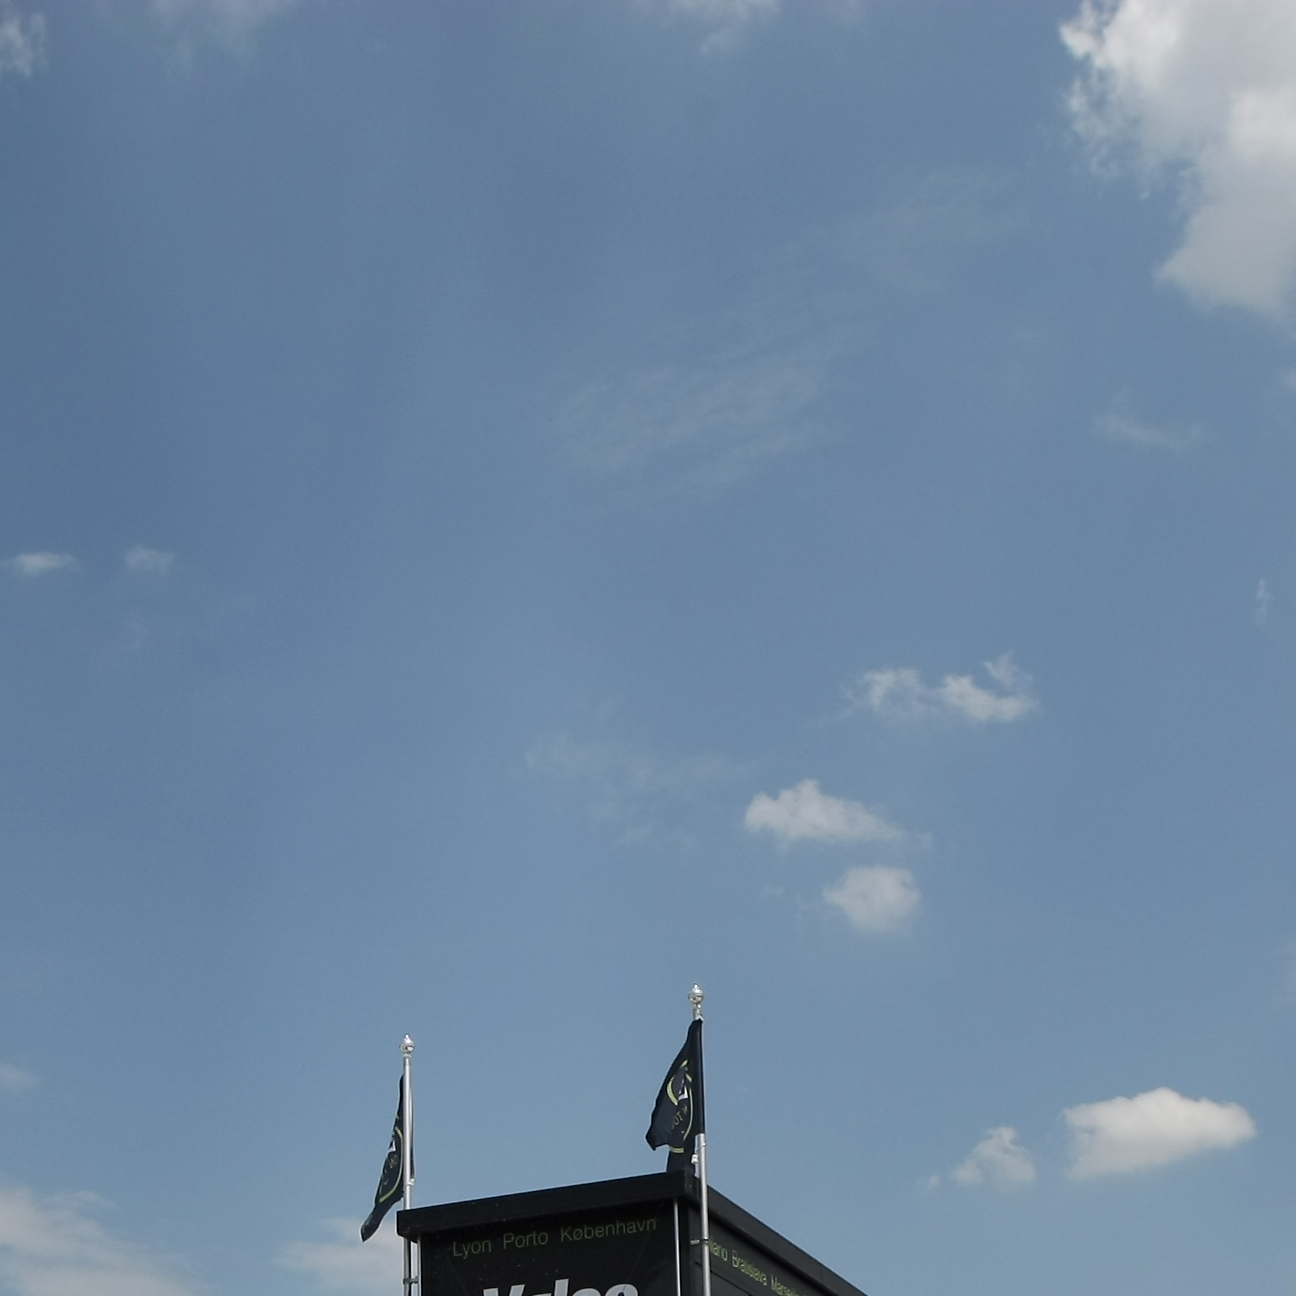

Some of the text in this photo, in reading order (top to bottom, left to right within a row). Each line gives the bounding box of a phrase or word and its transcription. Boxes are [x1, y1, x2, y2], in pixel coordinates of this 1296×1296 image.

[453, 1218, 657, 1259] Lyon Porto København
